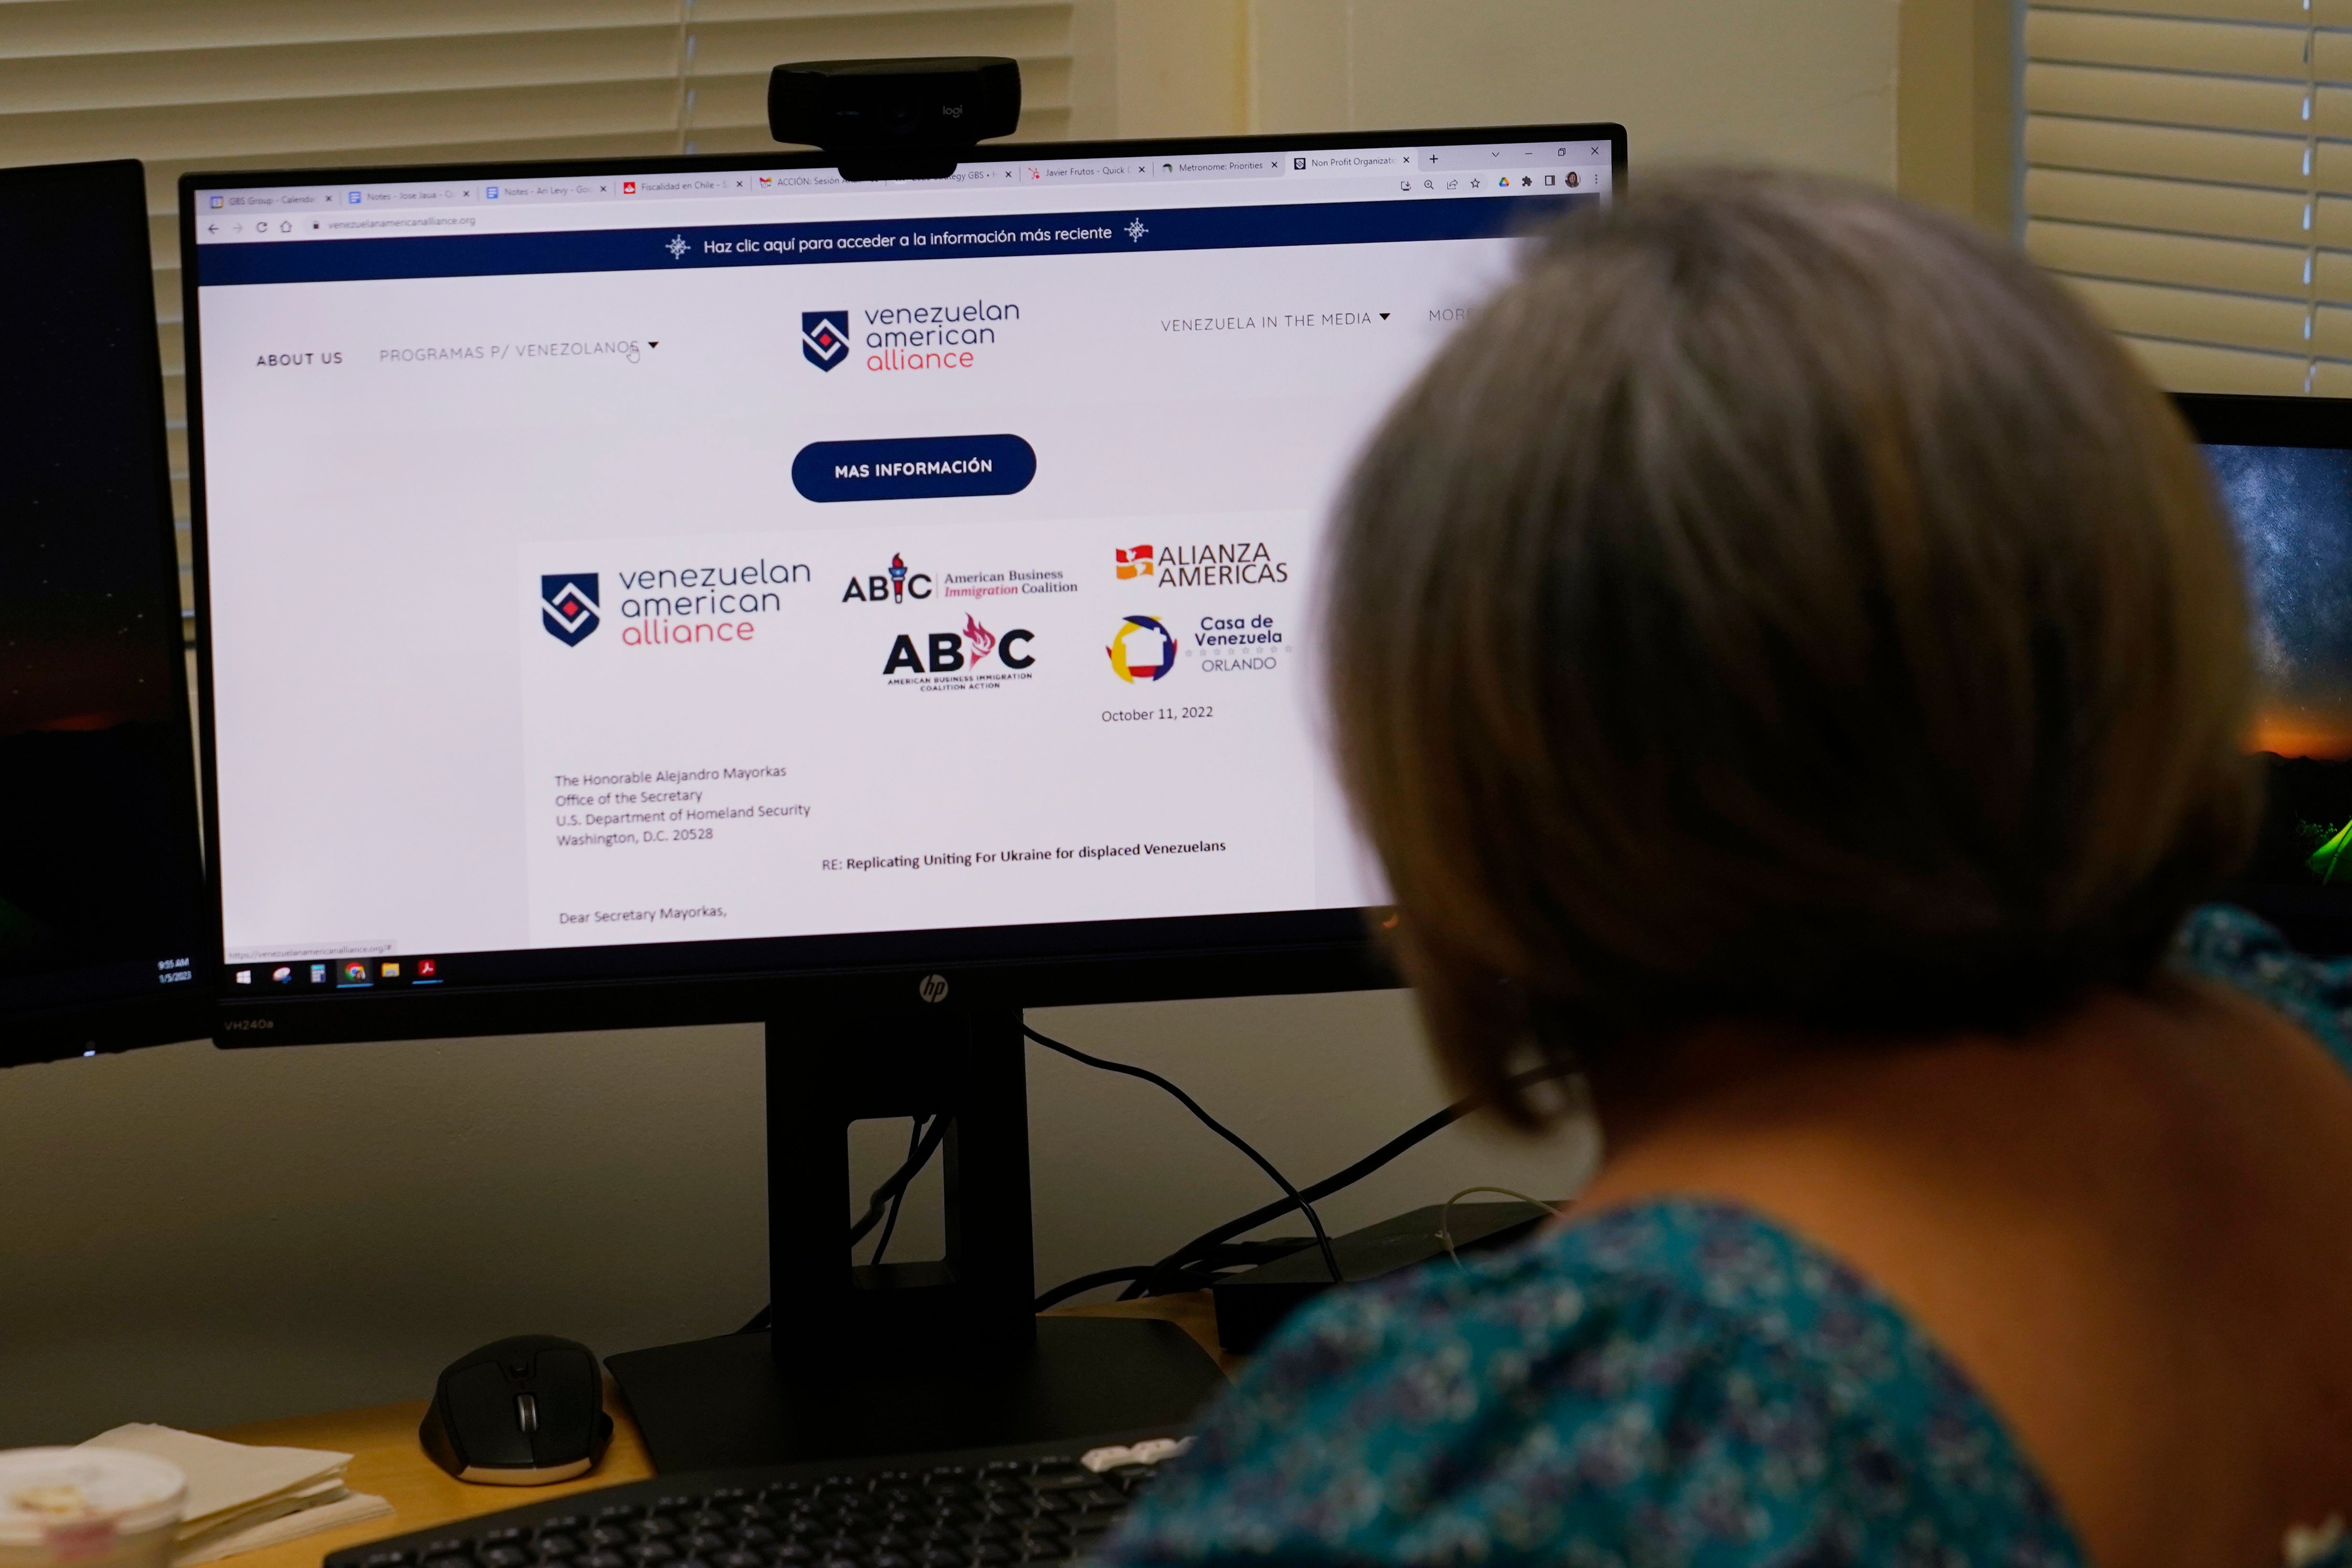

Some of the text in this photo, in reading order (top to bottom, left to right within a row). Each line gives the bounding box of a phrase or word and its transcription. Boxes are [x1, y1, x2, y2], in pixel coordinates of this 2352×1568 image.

[943, 105, 963, 118] logi
[1103, 167, 1125, 175] Quick
[1230, 162, 1263, 170] Priorities
[695, 180, 714, 189] Chile
[777, 176, 812, 186] ACCIÓN:
[704, 226, 1112, 254] Haz clic aquí para acceder a la información más reciente
[865, 299, 1019, 325] venezuelan
[1160, 312, 1371, 332] VENEZUELA IN THE MEDIA
[866, 325, 995, 348] american
[256, 352, 342, 366] ABOUT US
[380, 340, 639, 362] PROGRAMAS P/ VENEZOLANOS
[867, 349, 974, 371] alliance
[835, 457, 992, 478] MAS INFORMACIÓN
[1158, 542, 1271, 566] ALIANZA
[620, 559, 811, 590] venezuelan
[944, 569, 1063, 584] American Business
[1158, 562, 1288, 588] AMERICAS
[944, 582, 1078, 600] Immigration Coalition
[621, 589, 780, 618] american
[623, 619, 754, 646] alliance
[1200, 614, 1273, 631] Casa de
[1195, 630, 1282, 646] Venezuela
[1202, 657, 1276, 672] ORLANDO
[976, 673, 1032, 681] IMMIGRATION
[1102, 706, 1213, 722] October 11, 2022
[555, 765, 787, 787] The Honorable Alejandro Mayorkas
[555, 789, 703, 807] Office of the Secretary
[556, 804, 811, 827] U.S. Department of Homeland Security
[557, 827, 713, 847] Washington, D.C. 20528
[822, 840, 1226, 871] RE: Replicating Uniting For Ukraine for displaced Venezuelans
[560, 906, 727, 924] Dear Secretary Mayorkas,
[922, 974, 947, 1003] hp
